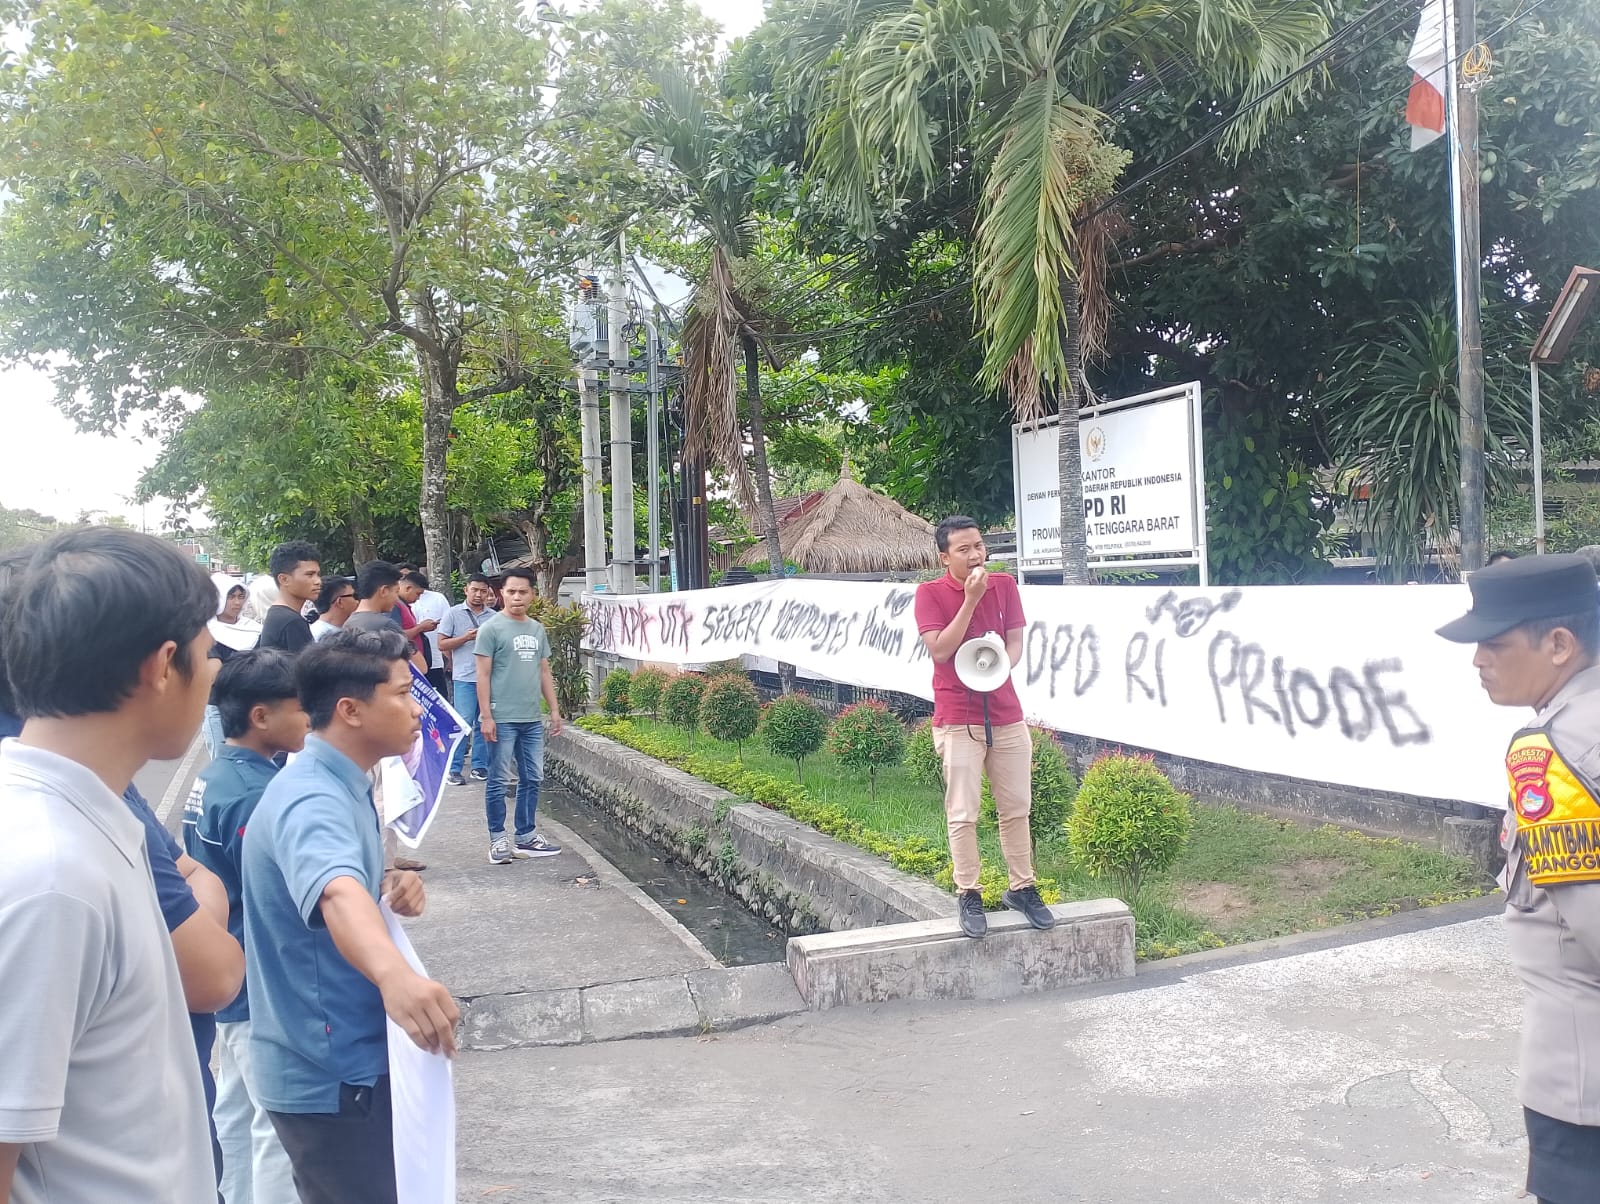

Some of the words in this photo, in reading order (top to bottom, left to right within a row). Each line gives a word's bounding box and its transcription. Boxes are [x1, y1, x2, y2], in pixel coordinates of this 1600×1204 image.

[1027, 491, 1046, 501] DEWAN
[1085, 482, 1109, 493] DAERAH
[1110, 477, 1143, 490] REPUBLIK
[1144, 472, 1182, 486] INDONESIA
[1081, 467, 1116, 482] KANTOR
[1084, 497, 1105, 518] PD
[1111, 494, 1126, 515] RI
[1094, 519, 1145, 536] TENGGARA
[1146, 516, 1180, 532] BARAT
[1026, 620, 1101, 699] DPD
[1125, 631, 1168, 707] RI
[1207, 629, 1433, 748] PRIODE
